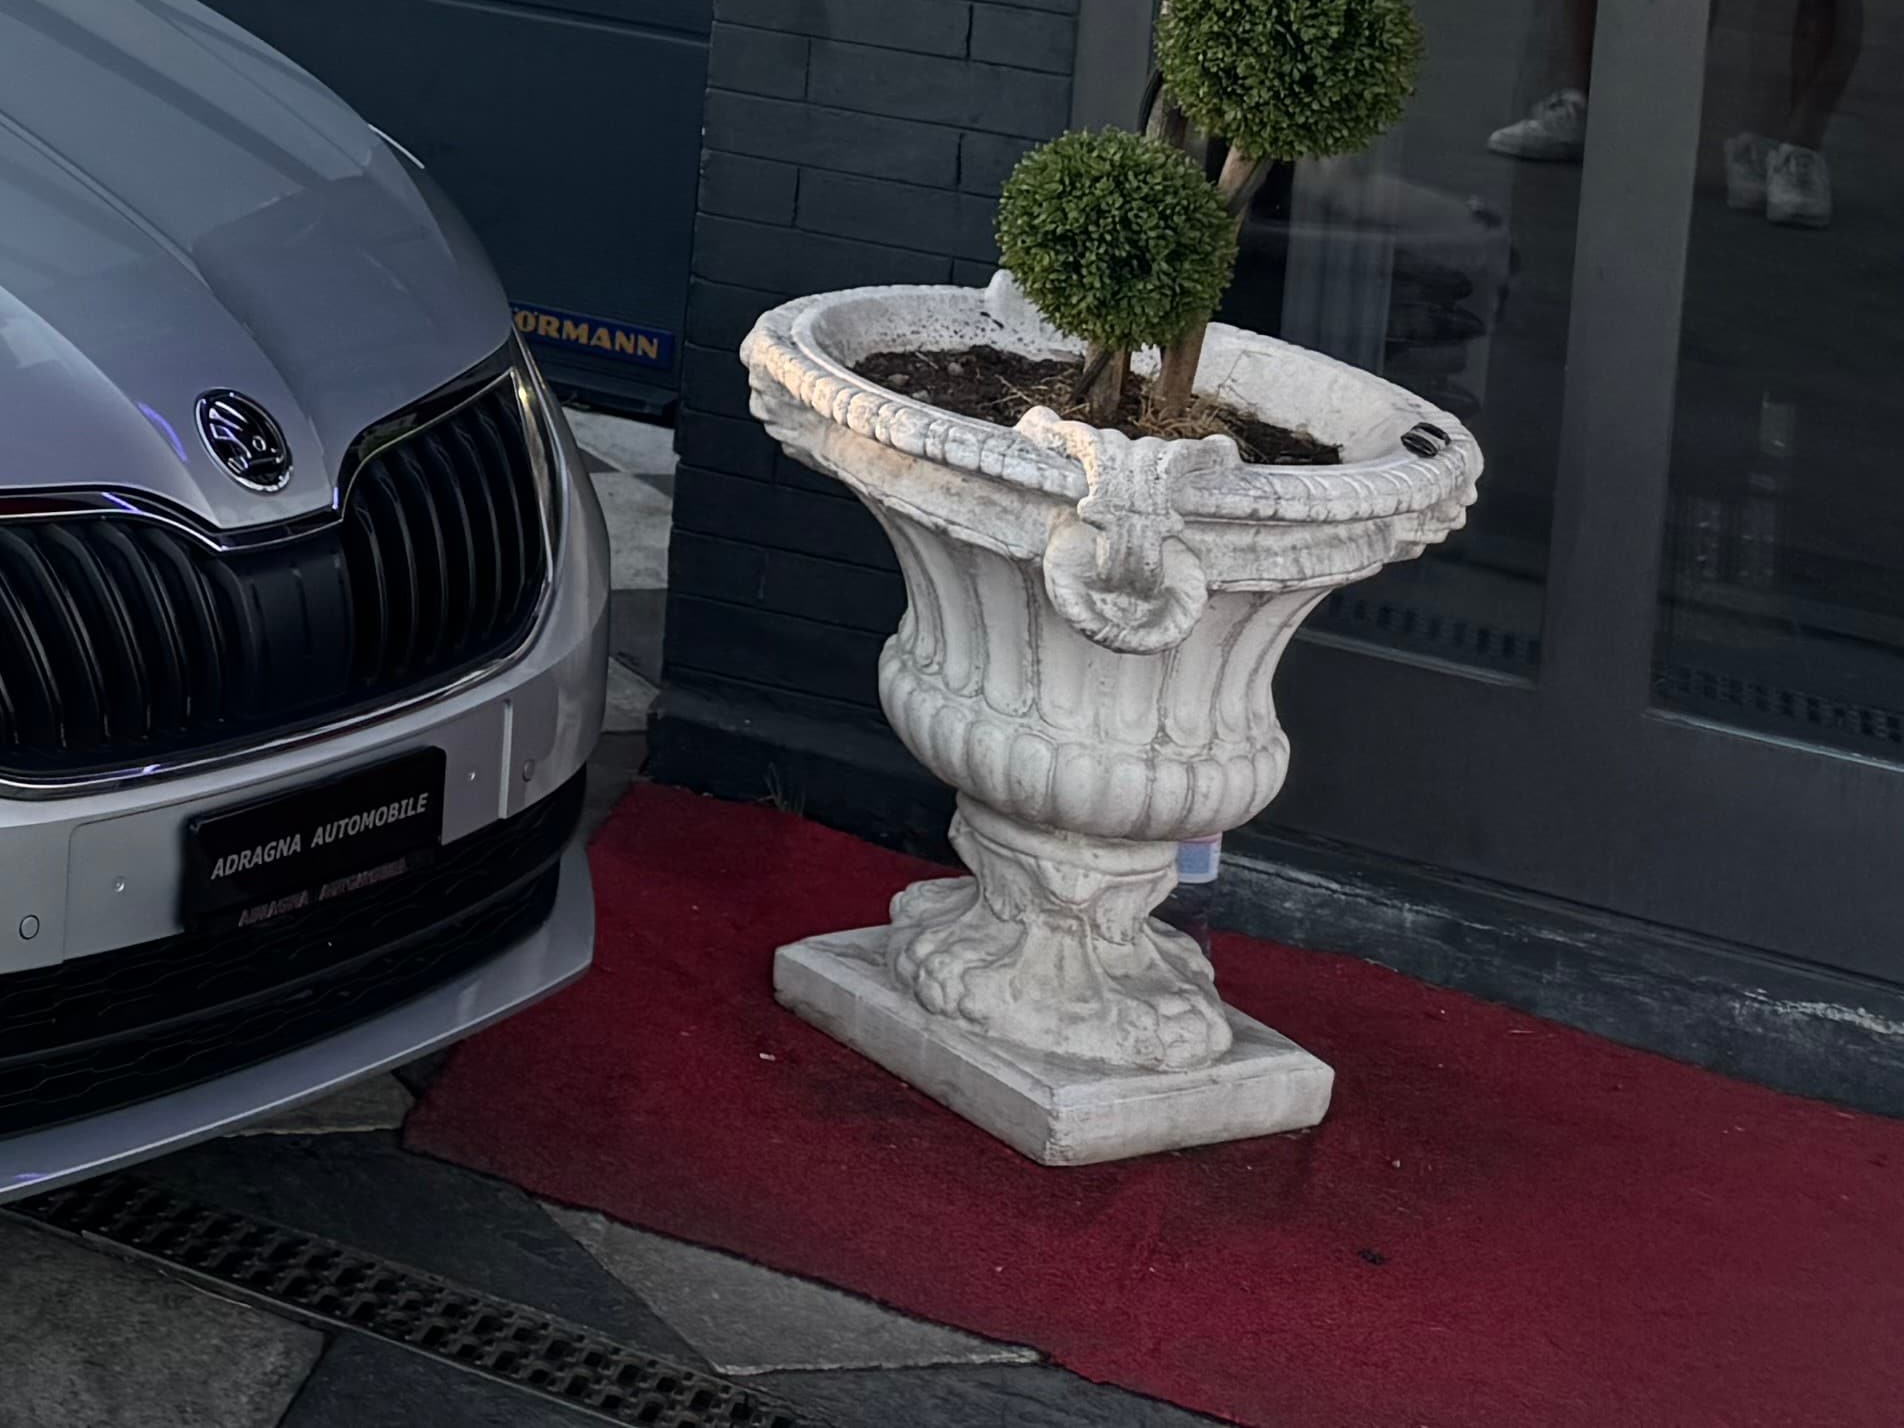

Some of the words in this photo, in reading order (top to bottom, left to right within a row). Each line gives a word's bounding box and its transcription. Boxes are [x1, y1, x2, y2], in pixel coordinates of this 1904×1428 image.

[513, 307, 660, 361] ÖRMANN
[209, 831, 302, 881] ADRAGNA
[310, 792, 430, 849] AUTOMOBILE
